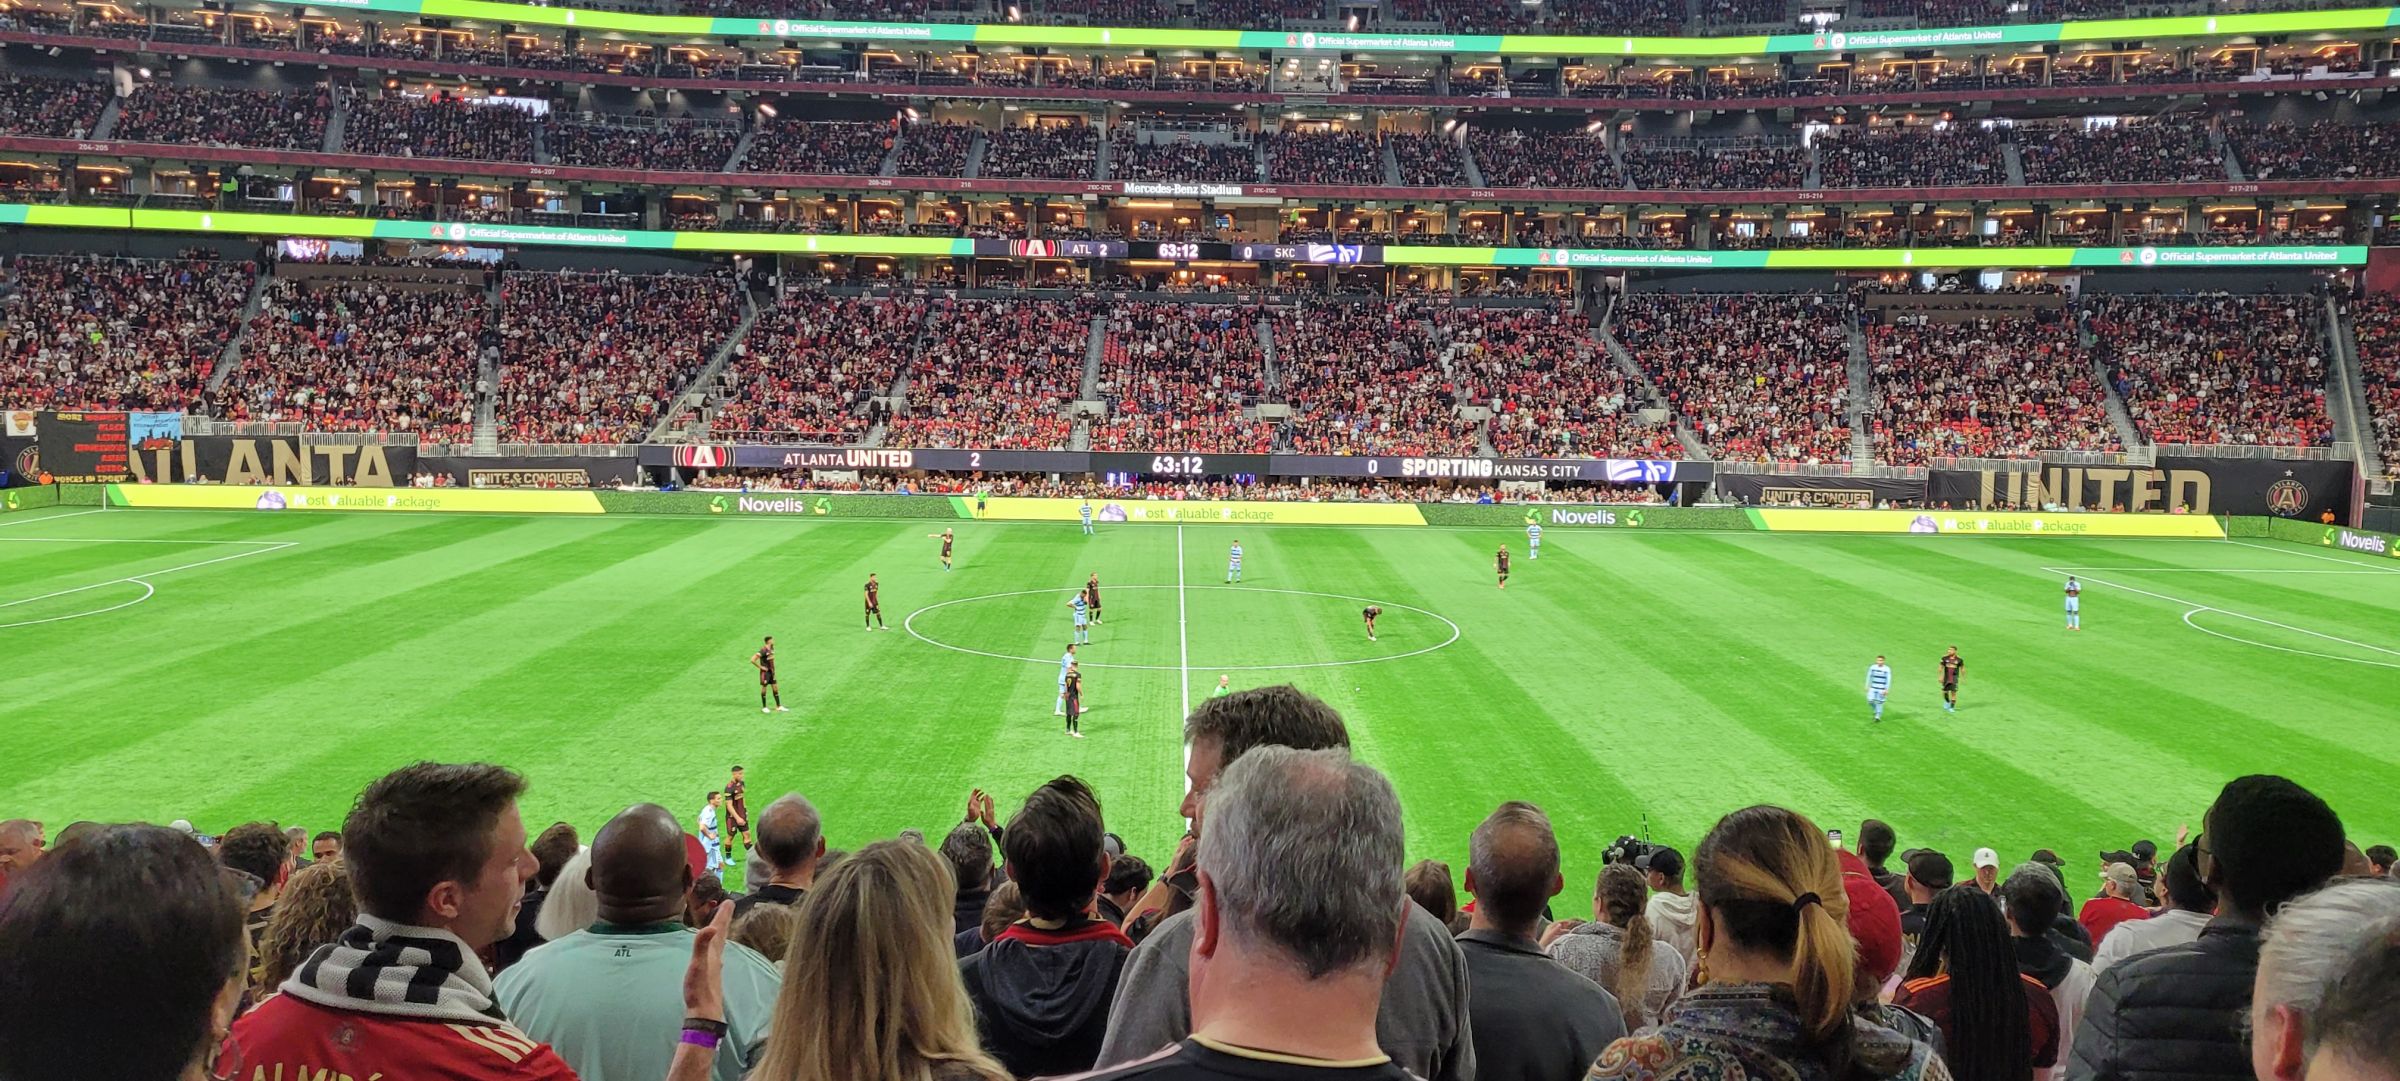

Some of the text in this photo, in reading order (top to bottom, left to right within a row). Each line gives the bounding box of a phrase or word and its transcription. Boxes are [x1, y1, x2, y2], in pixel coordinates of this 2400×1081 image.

[792, 24, 930, 36] Official Supermarket of Atlanta United
[1319, 37, 1454, 48] Official Supermarket of Atlanta United
[1849, 31, 2002, 46] Official Supermarket of Atlanta United
[1124, 182, 1242, 195] Mercedes-Benz Stadium
[469, 229, 625, 242] Official Supermarket of Atlanta United
[1072, 244, 1295, 258] ATL 2 63:12 0 SKC
[2161, 252, 2336, 262] Official Supermarket of Atlanta United
[1572, 254, 1712, 265] Official Supermarket of Atlanta United
[783, 449, 980, 468] ATLANTA UNITED 2
[1152, 456, 1203, 474] 63:12
[1368, 458, 1581, 478] 0 SPORTING KANSAS CITY
[472, 472, 509, 484] UNITE
[512, 473, 522, 484] &
[1766, 490, 1800, 501] UNITE
[1802, 491, 1811, 501] &
[1981, 467, 2210, 514] UNITED
[294, 495, 441, 510] Most Valuable Package
[739, 497, 803, 512] Novelis
[1134, 507, 1274, 522] Most Valuable Package
[1552, 508, 1616, 524] Novelis
[1945, 519, 2087, 533] Most Valuable Package
[2341, 530, 2385, 552] Novelis
[614, 949, 632, 957] ATL
